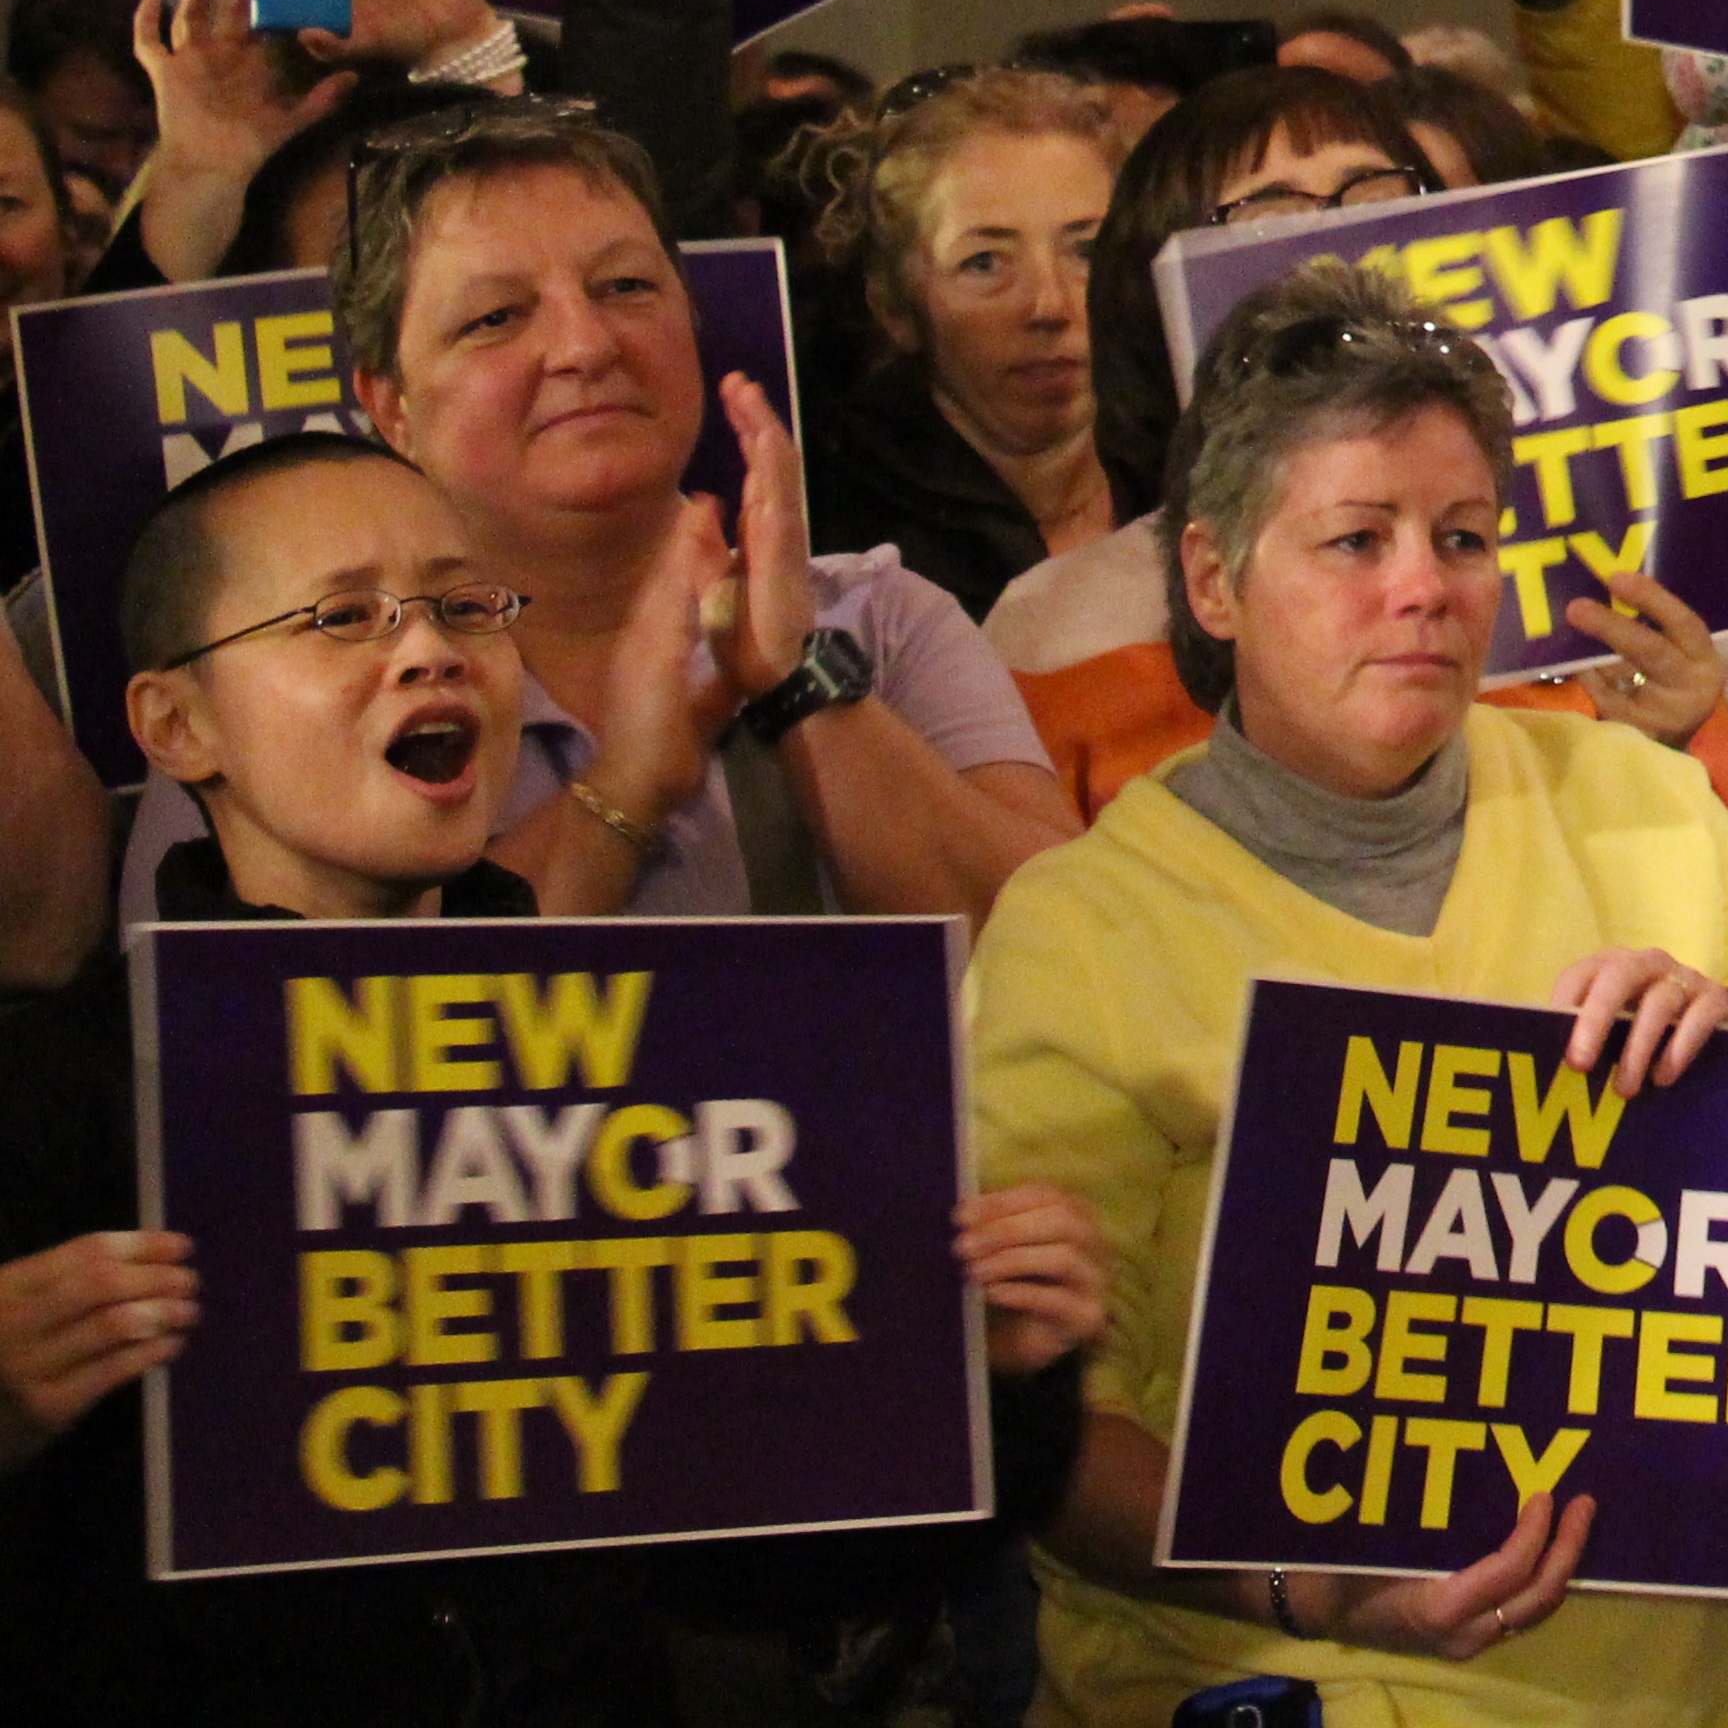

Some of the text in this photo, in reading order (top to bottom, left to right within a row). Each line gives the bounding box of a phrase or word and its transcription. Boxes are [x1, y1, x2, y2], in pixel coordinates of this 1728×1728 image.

[1308, 208, 1627, 330] EW
[151, 310, 342, 426] NE
[282, 970, 656, 1097] NEW
[291, 1098, 803, 1233] MAYOR
[1332, 1034, 1628, 1170] NEW
[297, 1229, 862, 1373] BETTER
[298, 1370, 653, 1512] CITY
[1279, 1408, 1592, 1531] CITY
